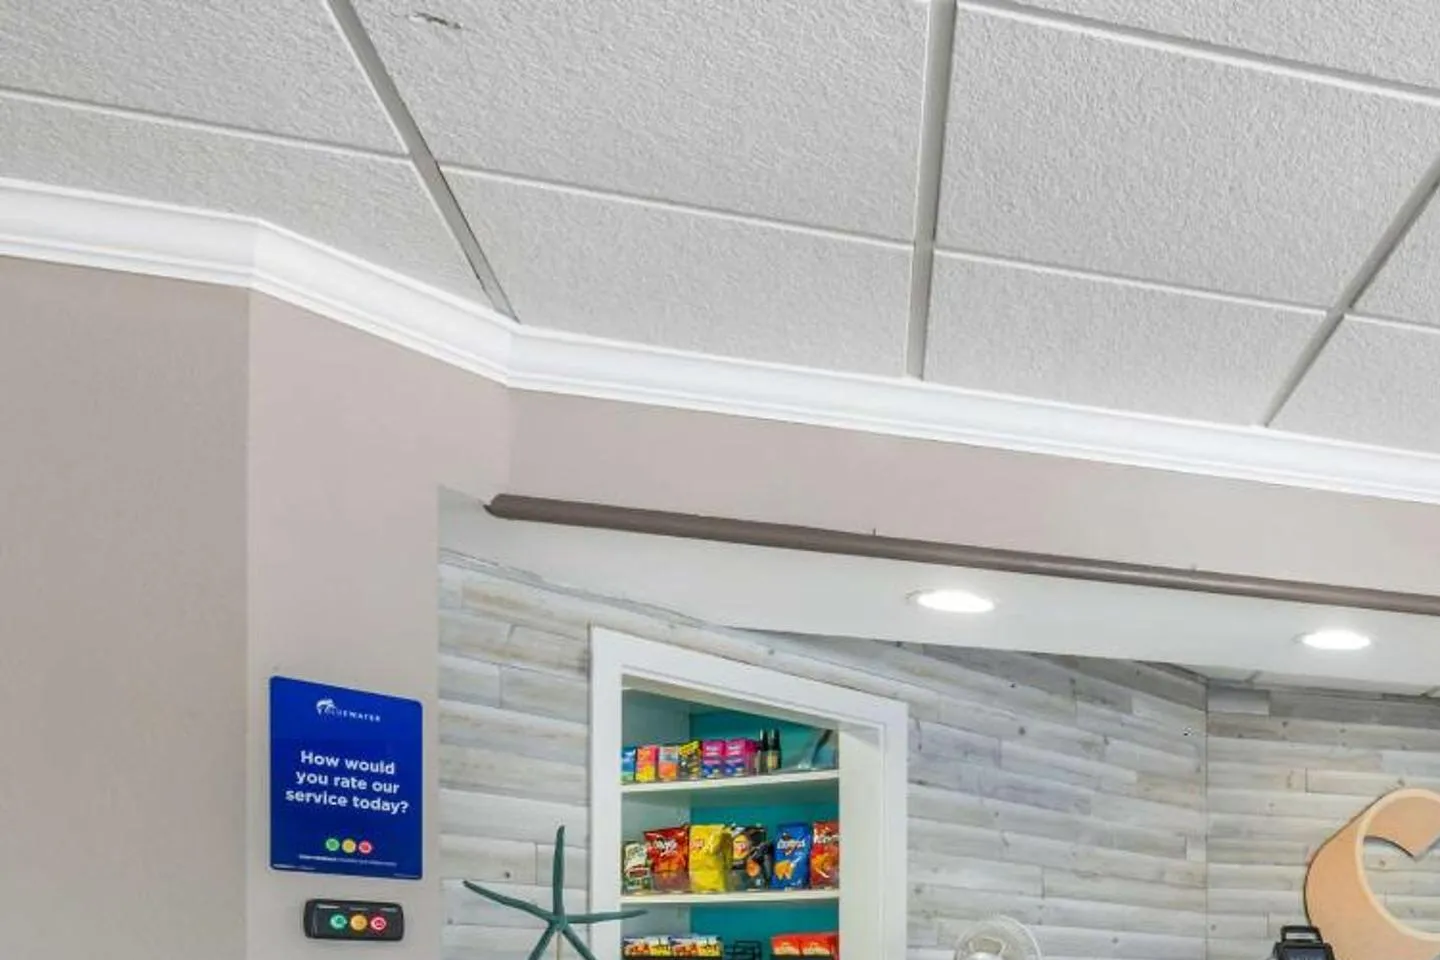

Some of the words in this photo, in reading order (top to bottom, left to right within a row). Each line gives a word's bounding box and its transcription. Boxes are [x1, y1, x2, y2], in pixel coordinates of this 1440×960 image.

[300, 750, 340, 768] How
[345, 759, 396, 775] would
[295, 771, 329, 785] you
[333, 776, 368, 790] rate
[372, 781, 400, 794] our
[285, 790, 348, 807] service
[353, 796, 409, 815] today?
